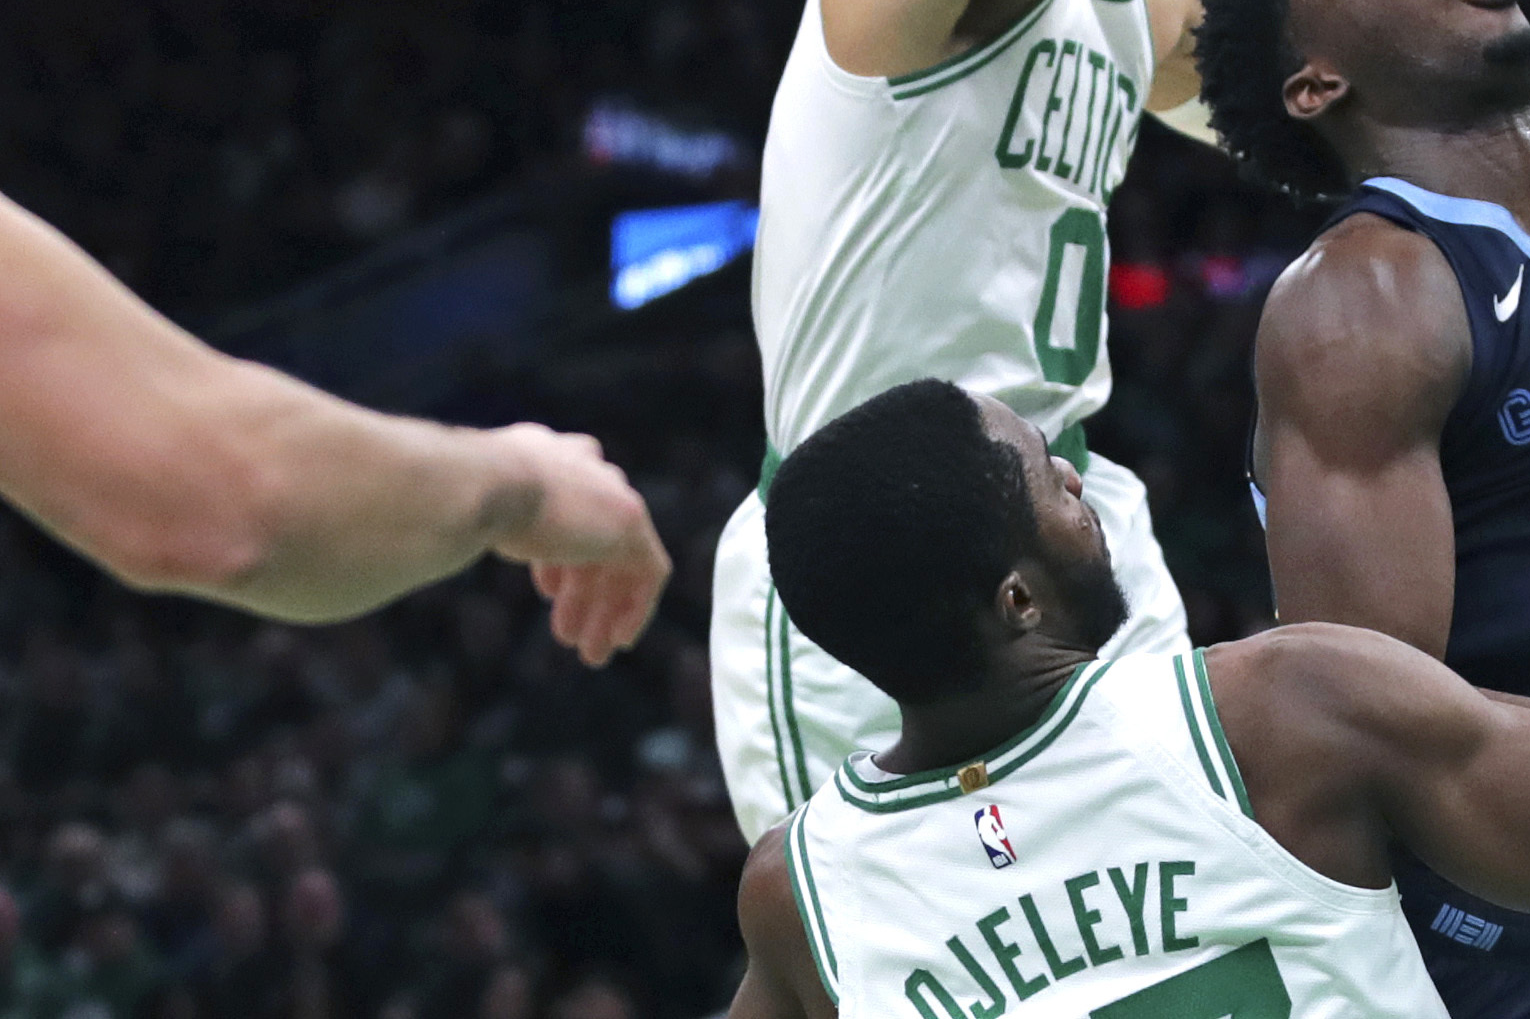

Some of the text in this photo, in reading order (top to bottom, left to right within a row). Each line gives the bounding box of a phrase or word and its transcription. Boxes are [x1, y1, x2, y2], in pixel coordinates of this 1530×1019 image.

[995, 38, 1140, 206] CELTIC
[1033, 207, 1105, 386] 0
[904, 861, 1199, 1019] OJELEYE
